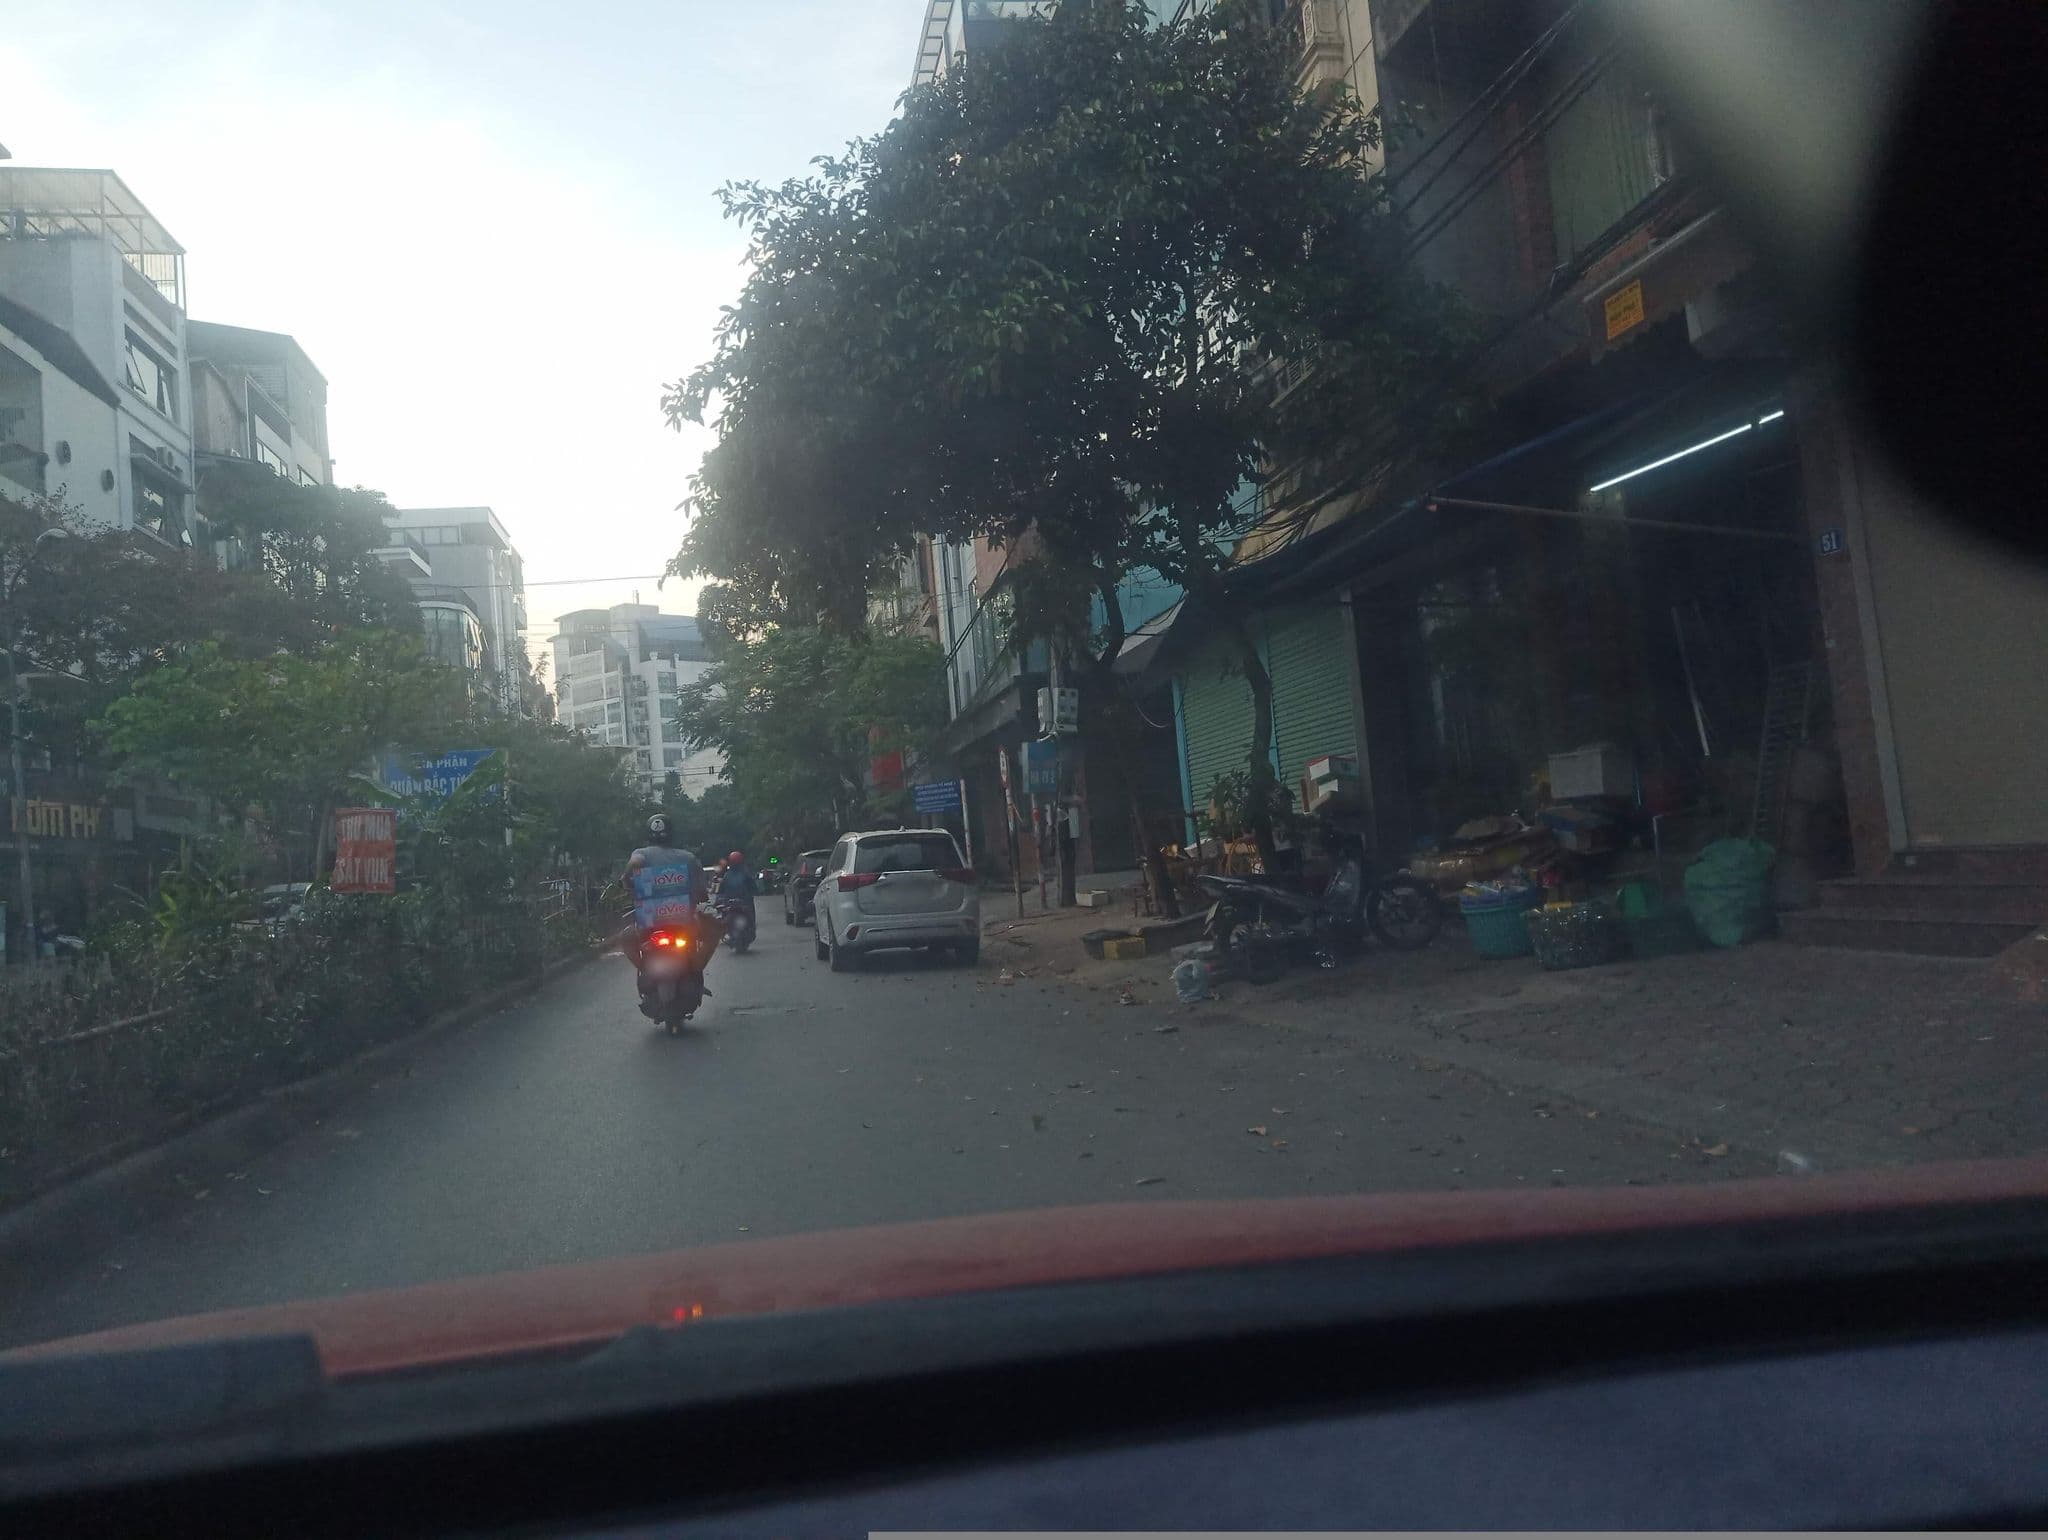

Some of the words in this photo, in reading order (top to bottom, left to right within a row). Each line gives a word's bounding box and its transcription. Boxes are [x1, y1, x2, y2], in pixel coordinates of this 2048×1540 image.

[1822, 532, 1838, 551] 51
[437, 756, 468, 769] PHẬN
[341, 815, 362, 840] THU
[364, 814, 392, 841] MUA
